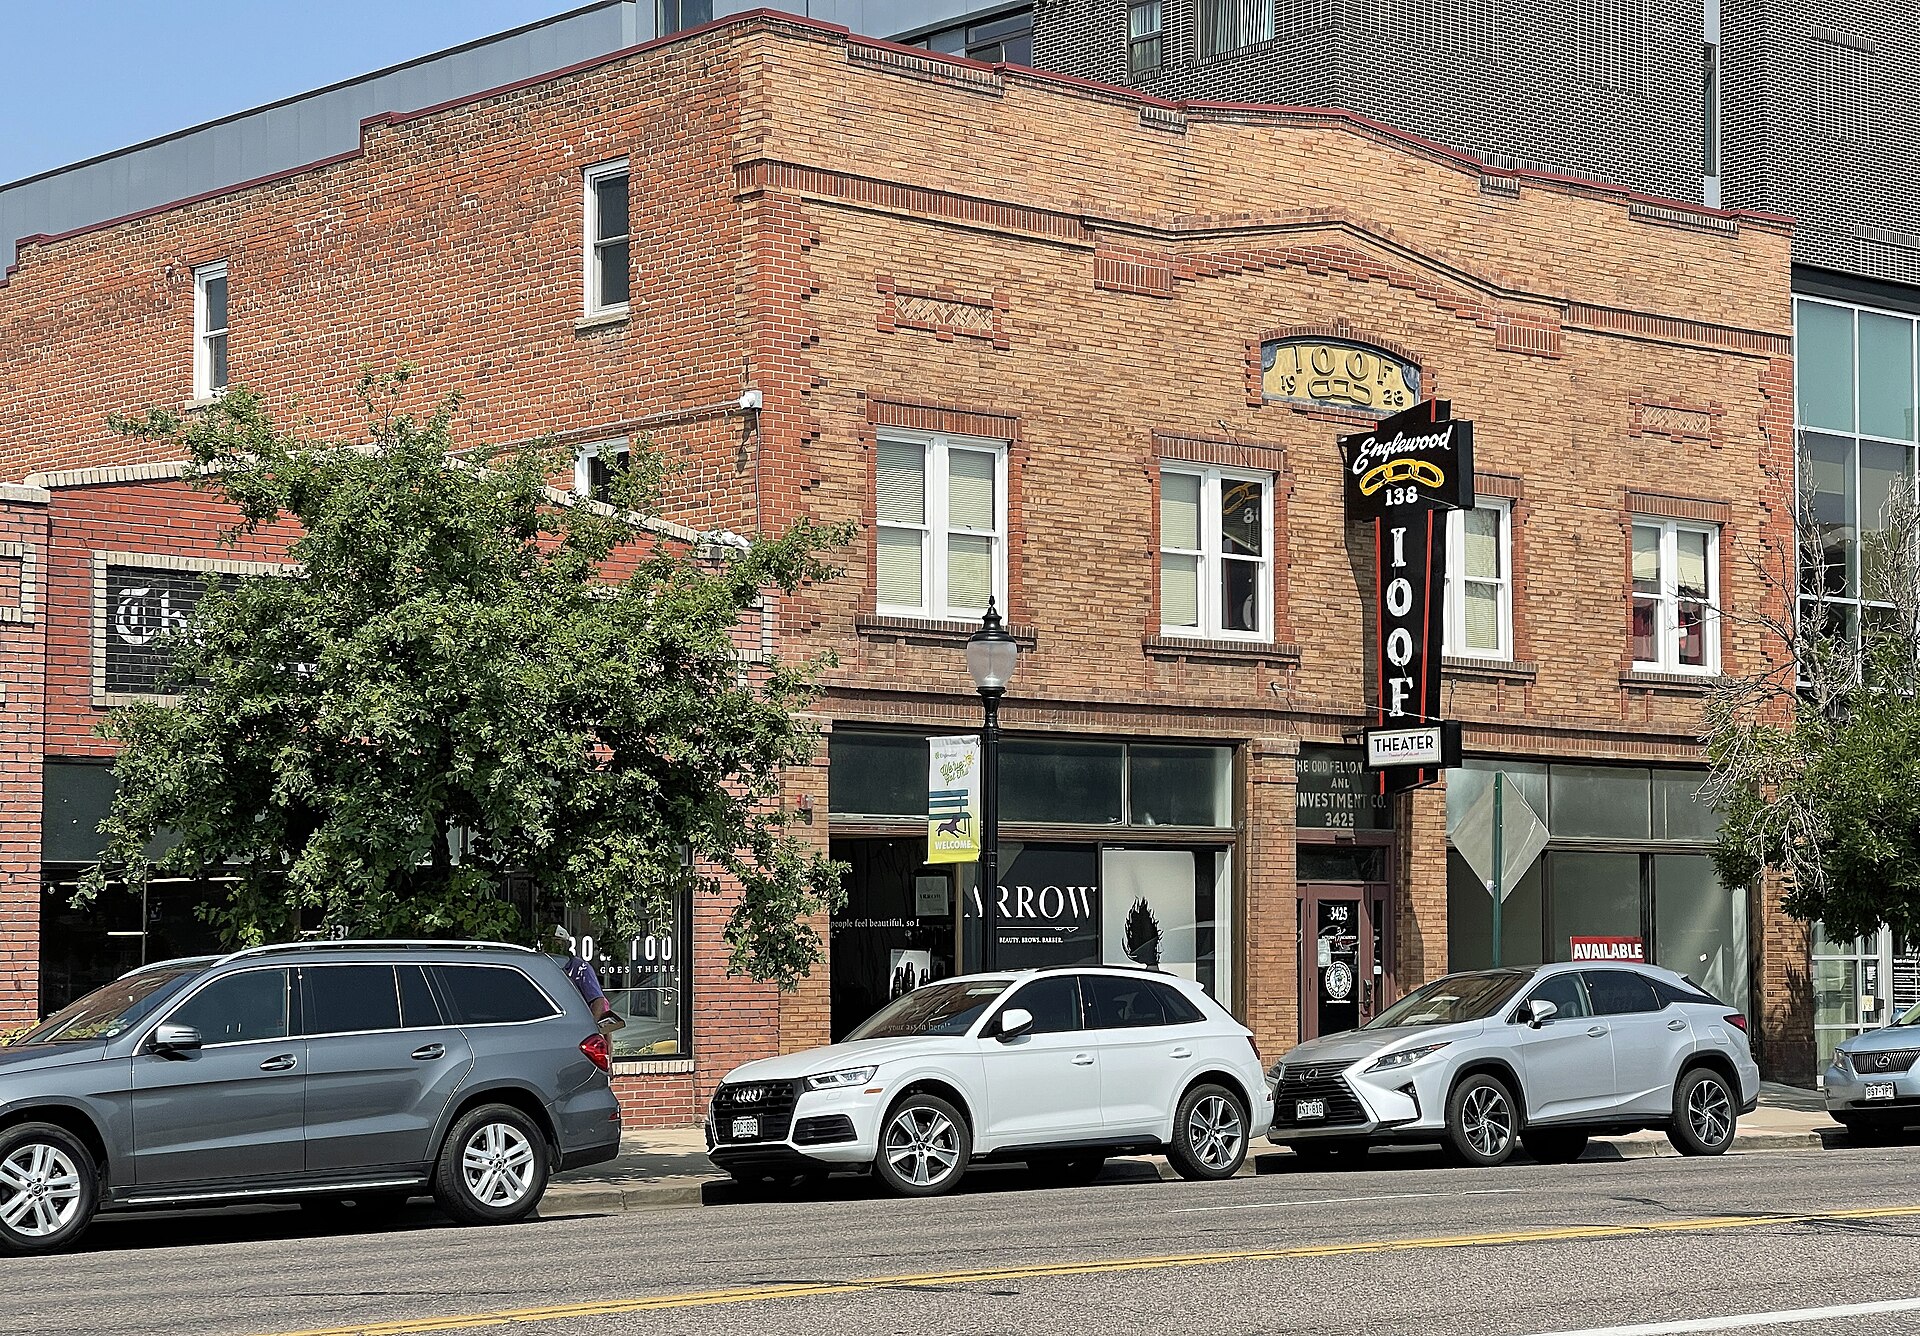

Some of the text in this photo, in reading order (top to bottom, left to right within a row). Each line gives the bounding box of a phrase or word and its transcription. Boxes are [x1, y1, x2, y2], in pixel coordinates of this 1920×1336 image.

[1280, 375, 1296, 395] 19
[1352, 425, 1454, 475] Englewood
[1385, 486, 1418, 506] 138
[1386, 527, 1414, 717] IOOF
[1374, 735, 1434, 753] THEATER
[1297, 760, 1370, 775] HE ODD FELLOW
[1296, 793, 1387, 809] INVESTMENT CO.
[1325, 812, 1355, 827] 3425
[1330, 906, 1348, 921] 3425
[830, 920, 853, 929] people
[854, 918, 868, 928] feel
[869, 918, 905, 928] beautiful,
[1573, 943, 1643, 959] AVAILABLE
[600, 966, 630, 974] GOES
